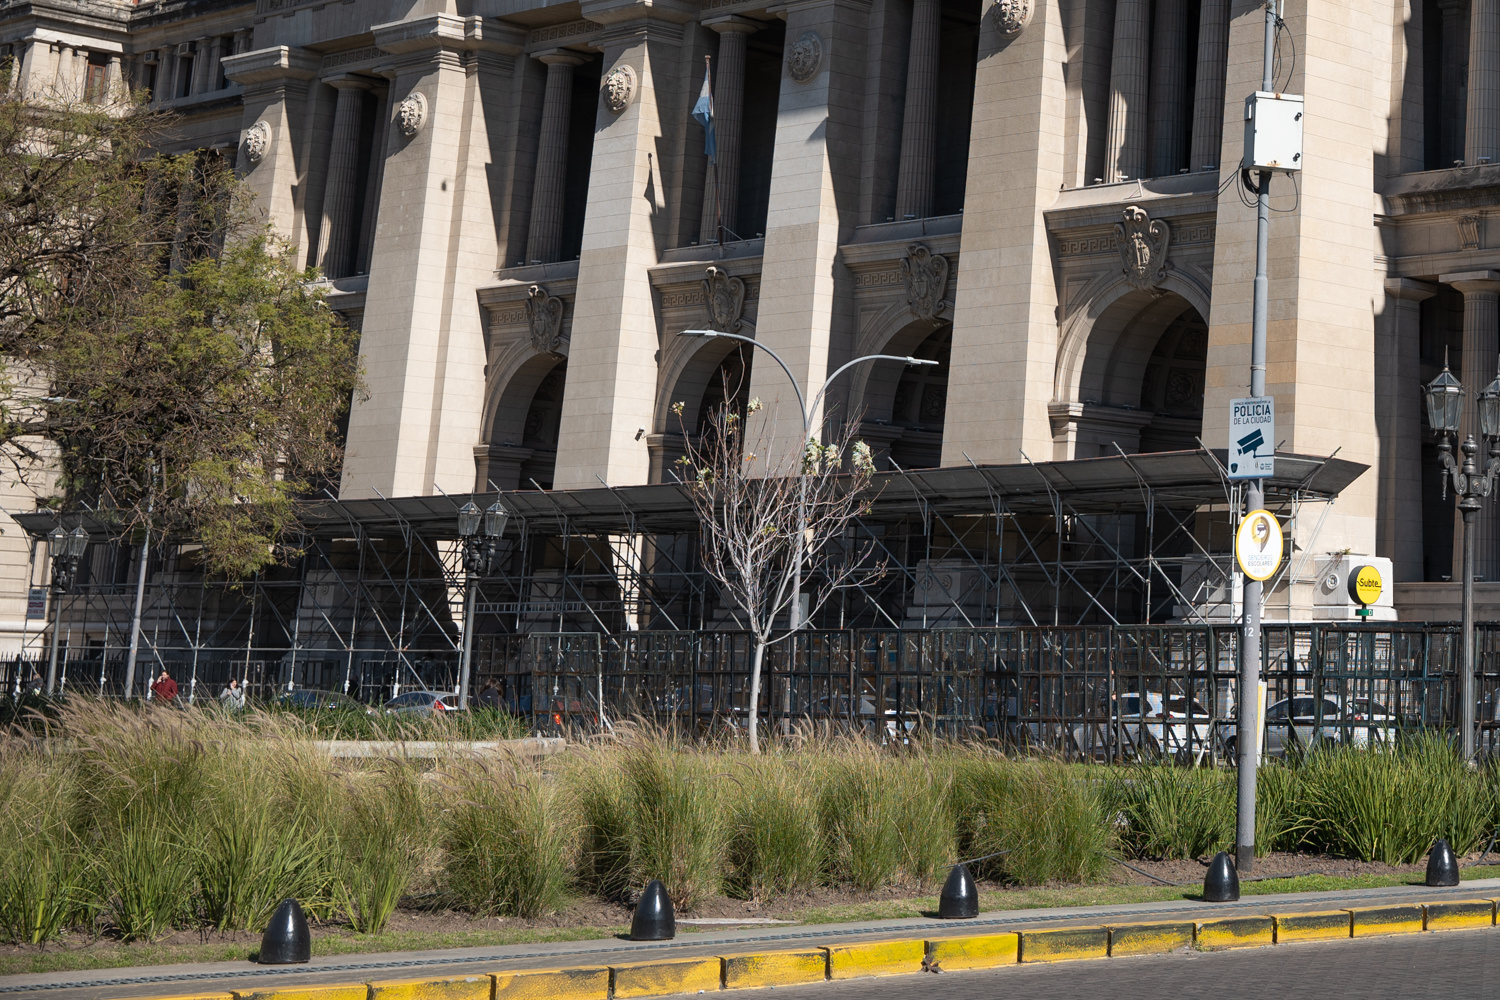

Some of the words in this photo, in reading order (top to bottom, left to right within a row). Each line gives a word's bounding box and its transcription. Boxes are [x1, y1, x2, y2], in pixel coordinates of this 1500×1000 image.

[1234, 404, 1271, 417] POLICIA
[1250, 416, 1272, 424] CIUDAD
[1358, 578, 1380, 588] Subte
[1246, 614, 1252, 624] 5
[1244, 627, 1254, 636] 12
